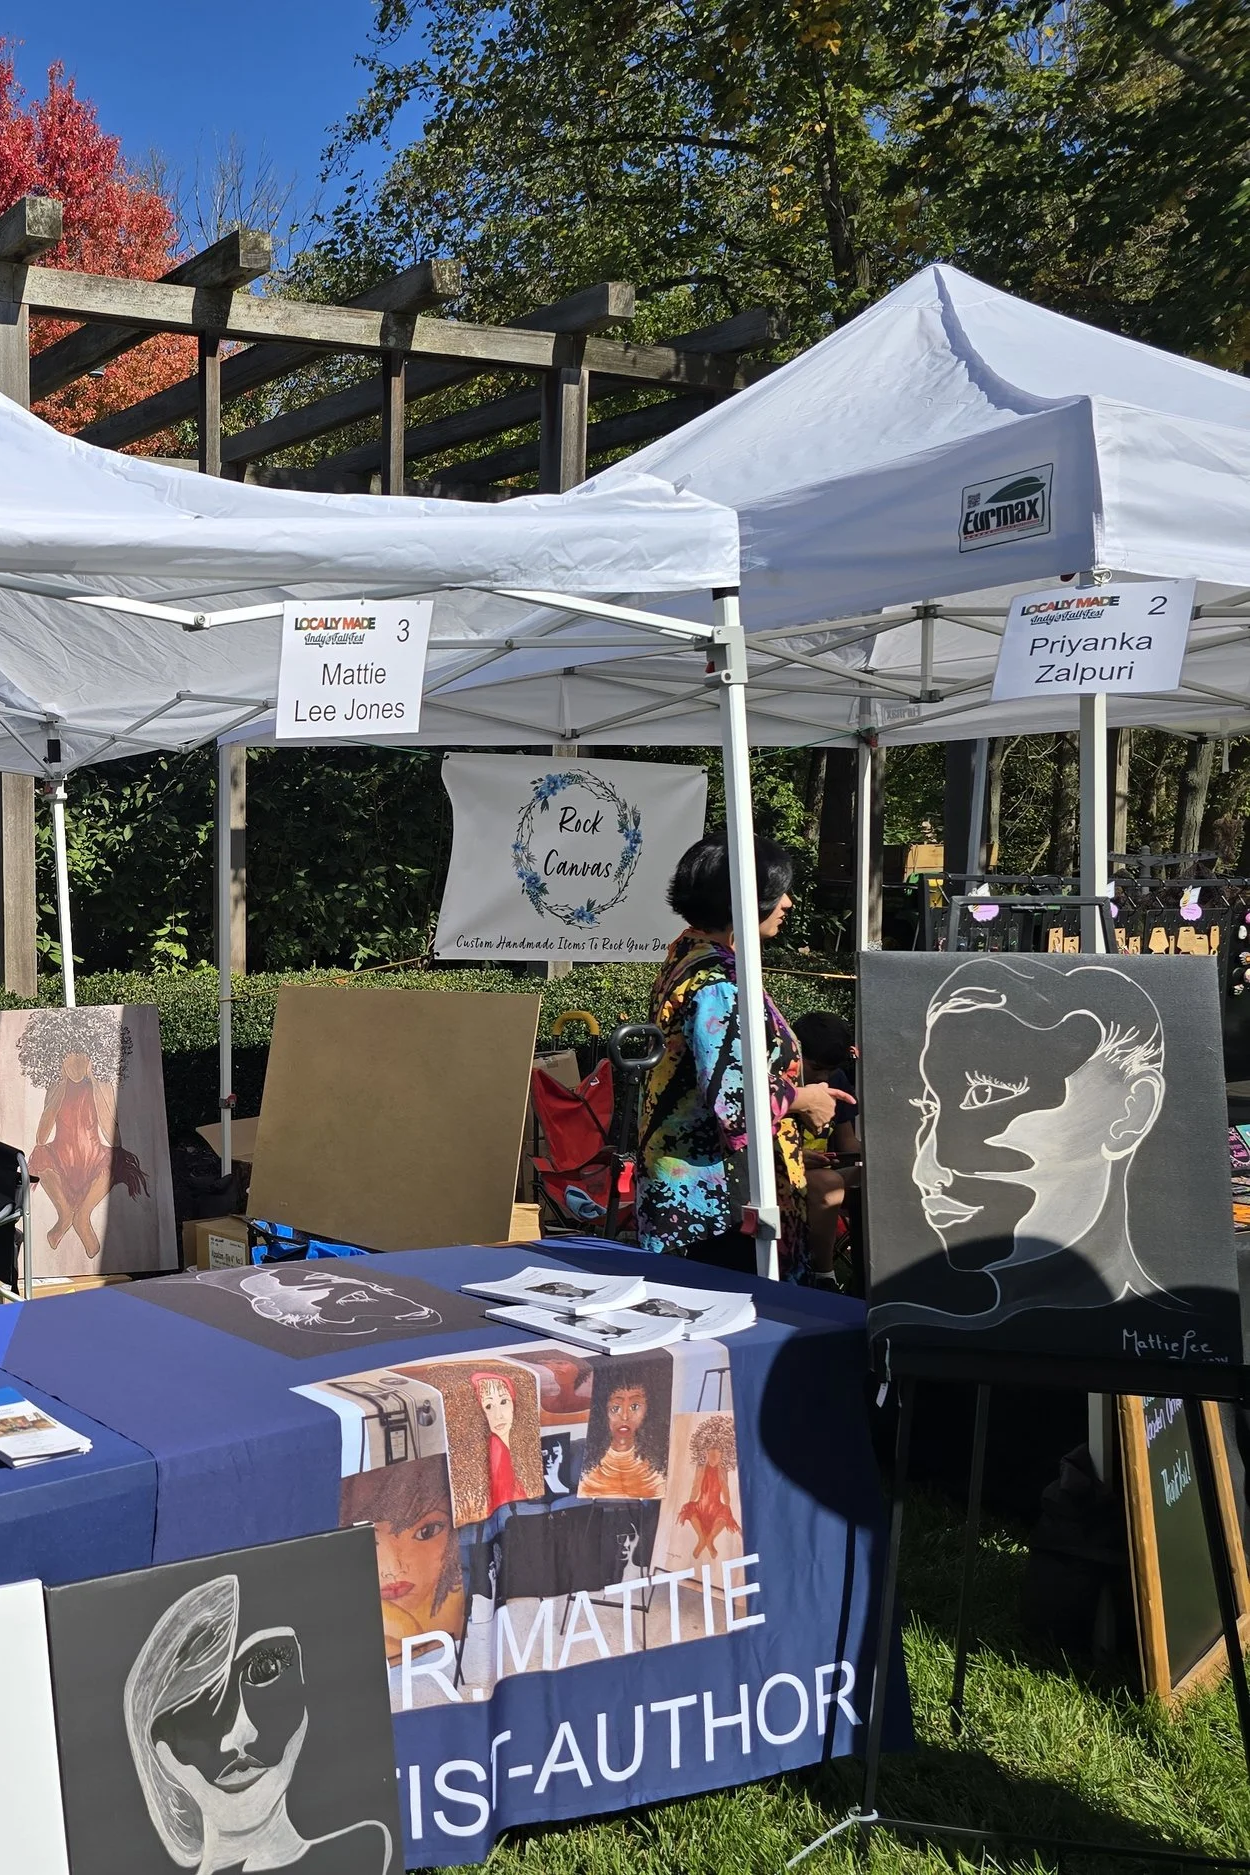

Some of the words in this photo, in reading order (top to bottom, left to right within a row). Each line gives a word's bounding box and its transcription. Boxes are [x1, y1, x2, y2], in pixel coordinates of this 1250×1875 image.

[963, 497, 1040, 536] Eurmax
[1021, 599, 1076, 616] LOCALLY
[1076, 596, 1120, 608] MADE
[1030, 612, 1062, 626] Indy's
[1061, 610, 1083, 622] Fall
[1082, 608, 1105, 620] Fest
[1148, 596, 1168, 616] 2
[294, 617, 342, 631] LOCALLY
[342, 617, 376, 630] MADE
[397, 619, 410, 642] 3
[304, 633, 332, 648] Indy's
[331, 632, 349, 645] Fall
[348, 632, 366, 645] Fest
[1029, 632, 1152, 658] Priyanka
[321, 662, 387, 686] Mattie
[1034, 661, 1135, 686] Zalpuri
[294, 700, 337, 723] Lee
[344, 698, 405, 721] Jones
[559, 806, 604, 836] Rock
[543, 849, 613, 879] Canvas
[456, 934, 494, 949] Custom
[496, 935, 554, 951] Handmade
[558, 936, 586, 950] Items
[588, 936, 598, 950] To
[602, 937, 624, 951] Rock
[626, 937, 650, 952] Your
[387, 1629, 484, 1711] R.
[496, 1552, 766, 1681] MATTIE
[396, 1659, 863, 1840] IST-AUTHOR
